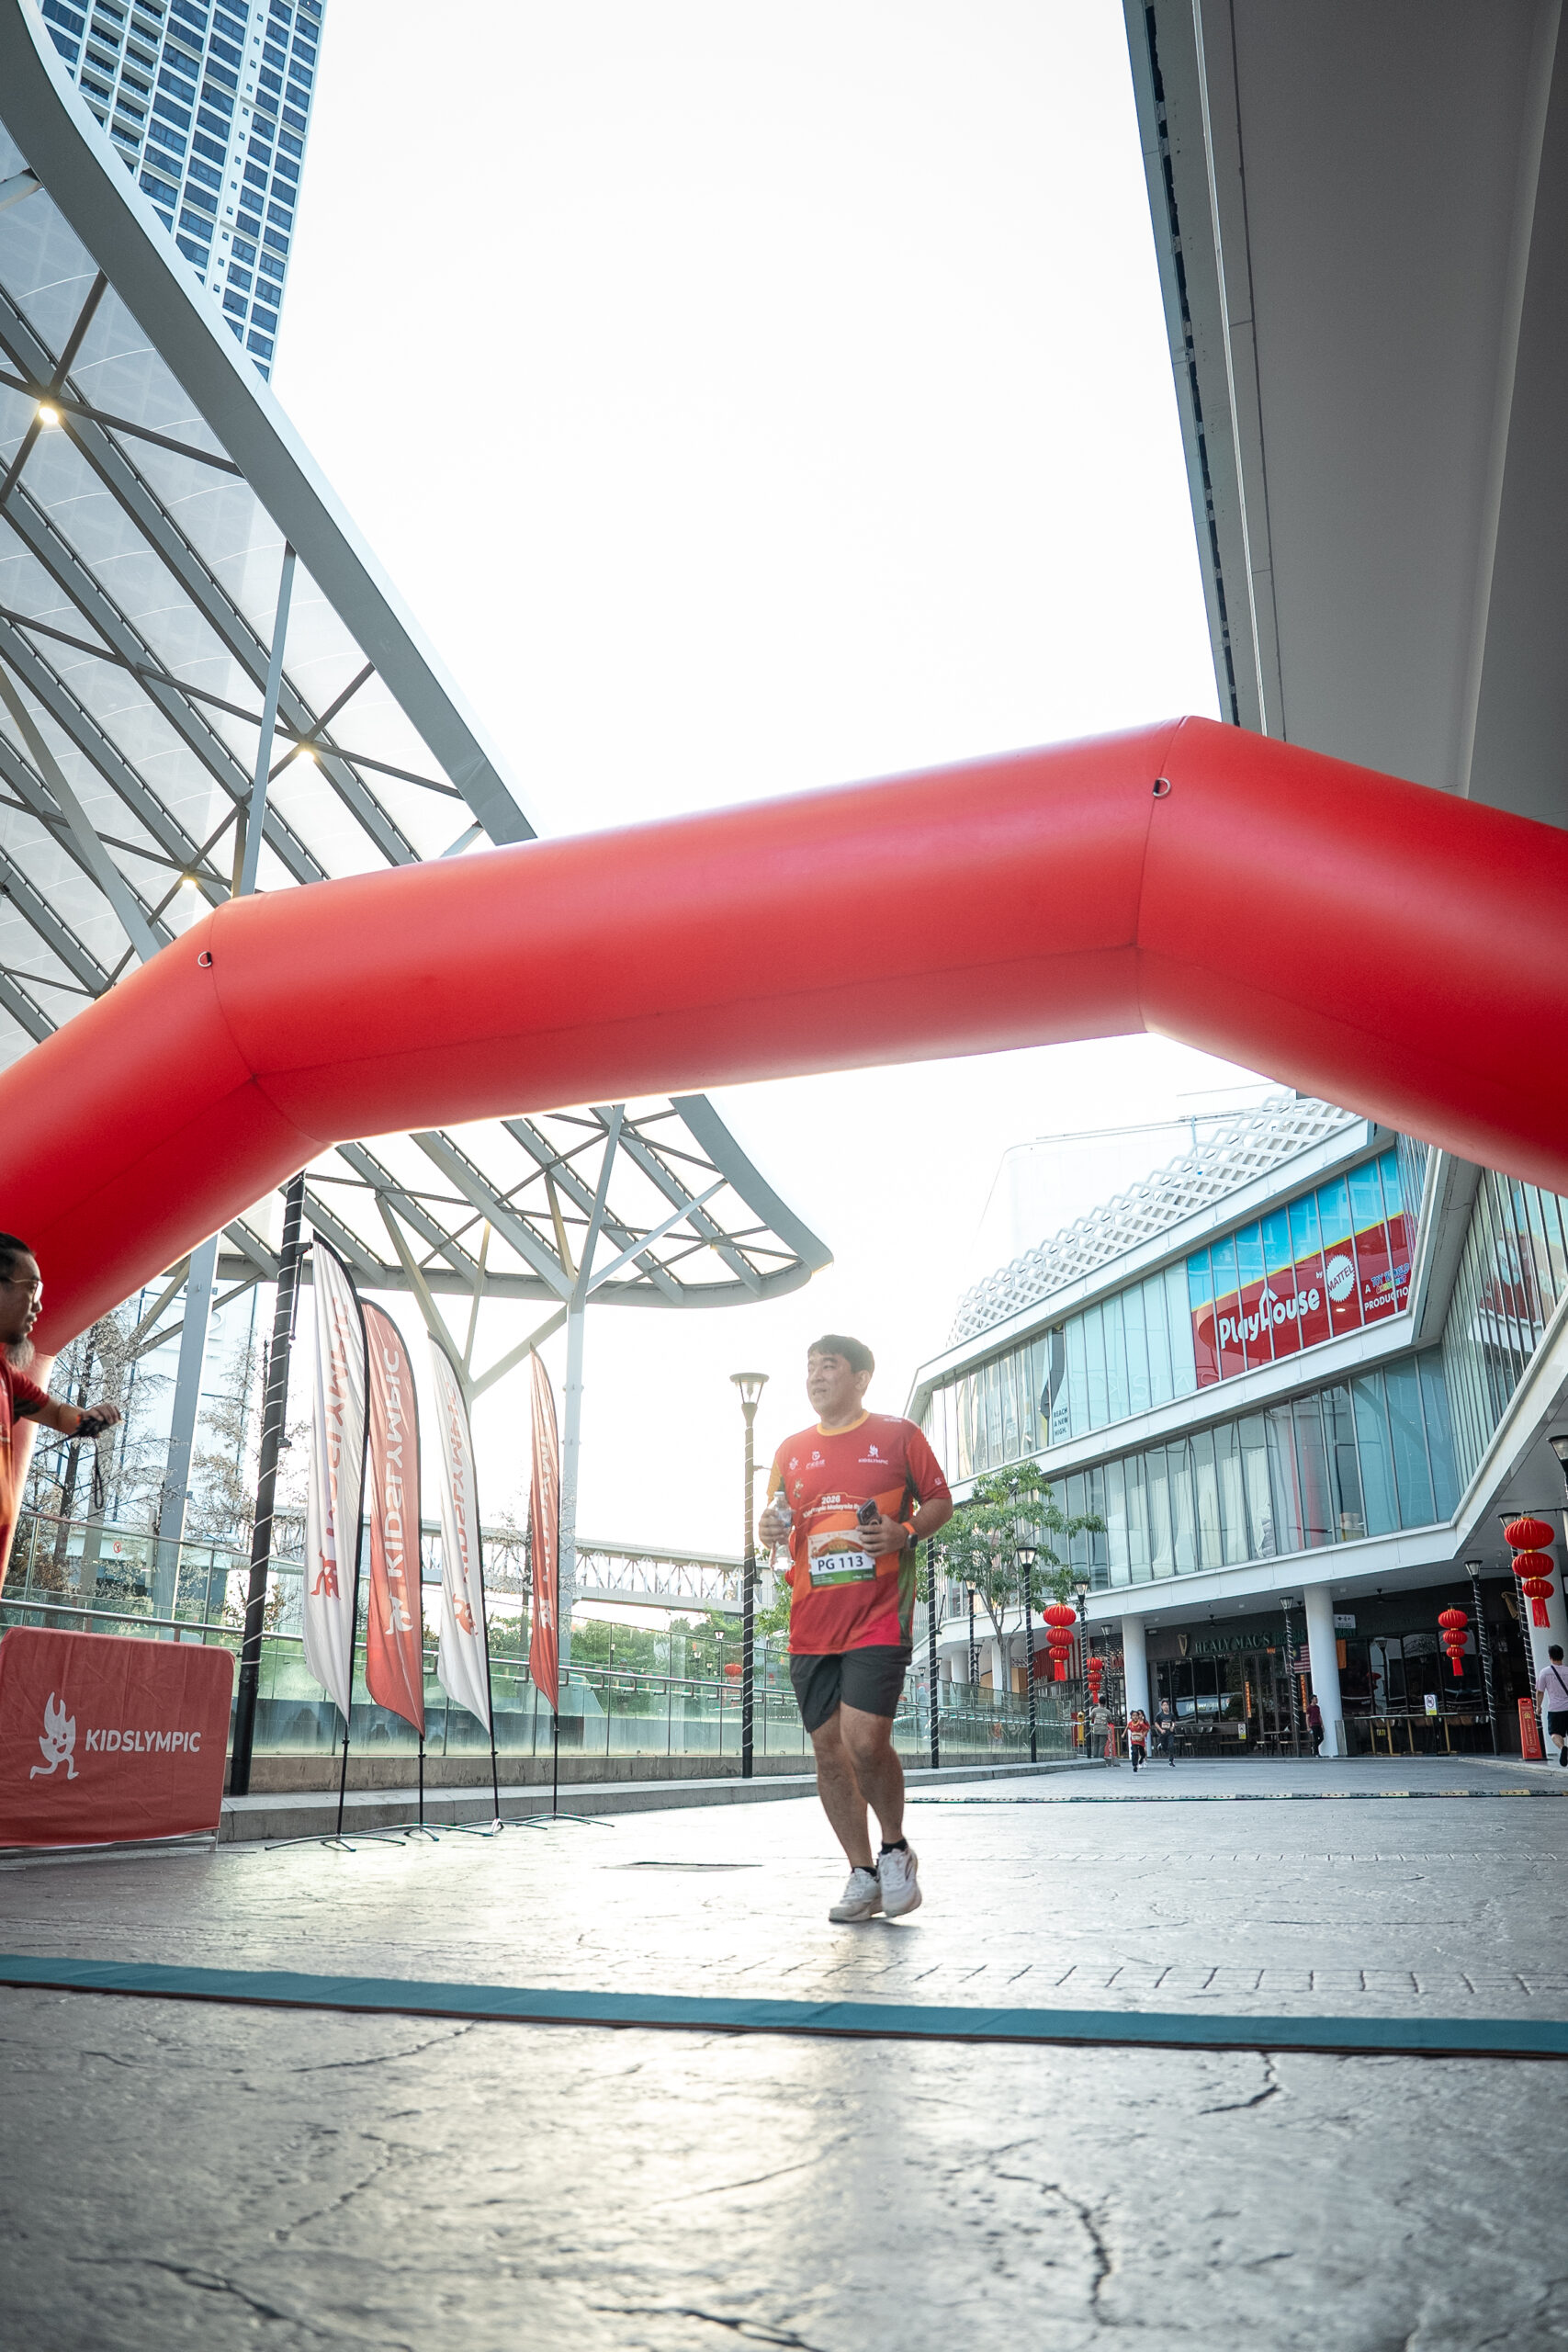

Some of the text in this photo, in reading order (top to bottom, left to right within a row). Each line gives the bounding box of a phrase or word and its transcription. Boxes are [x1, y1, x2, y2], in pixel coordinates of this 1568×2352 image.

[1315, 1265, 1354, 1292] by MATTEL
[1365, 1284, 1371, 1294] A
[1371, 1273, 1383, 1287] TOY
[1364, 1286, 1410, 1311] PRODUCTIO
[1054, 1407, 1067, 1418] REACH
[1058, 1417, 1068, 1426] NEW
[818, 1555, 863, 1571] PG 113
[1195, 1638, 1229, 1654] HEALY
[1235, 1633, 1269, 1649] MAC'S
[85, 1729, 201, 1752] KIDSLYMPIC
